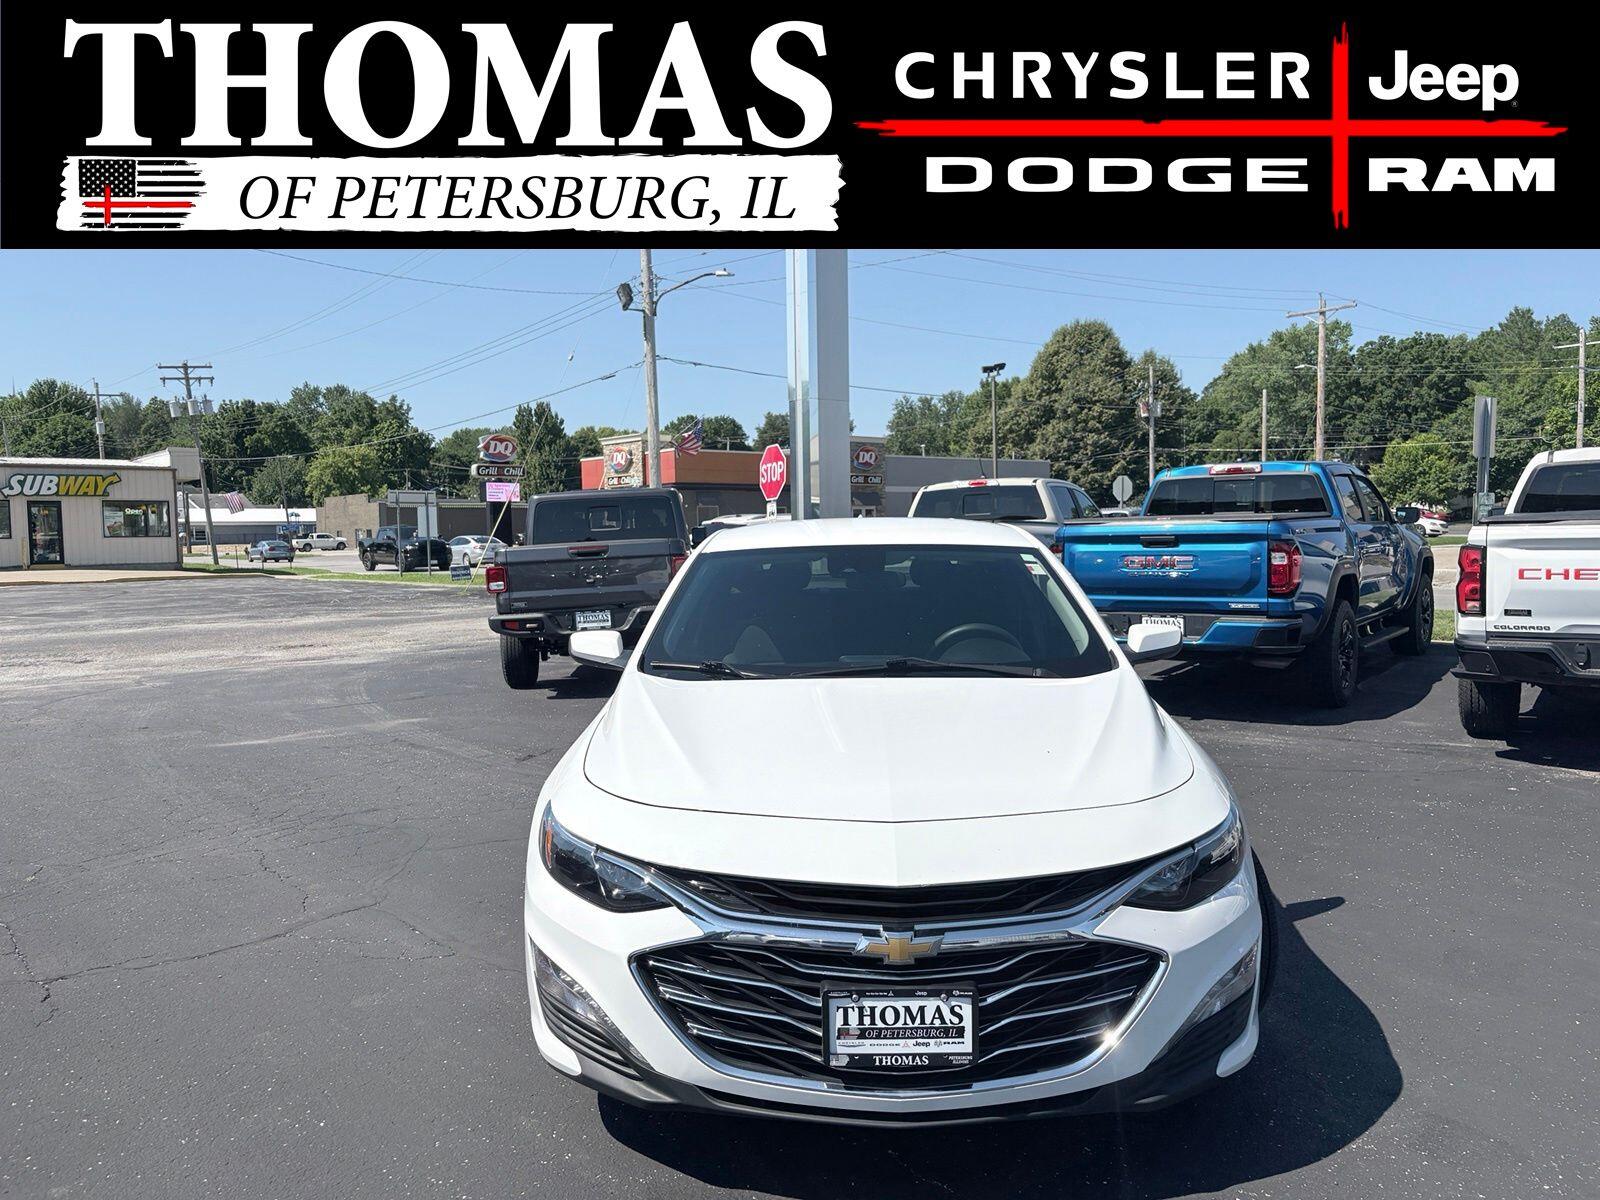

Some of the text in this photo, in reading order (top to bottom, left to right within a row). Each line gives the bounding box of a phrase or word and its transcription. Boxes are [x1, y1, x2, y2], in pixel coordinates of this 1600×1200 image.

[488, 440, 513, 456] DQ
[613, 451, 626, 466] DQ
[859, 451, 876, 465] DQ
[479, 466, 523, 476] Grill Chill
[761, 461, 784, 484] STOP
[1, 473, 121, 497] SUBWAY
[1124, 555, 1194, 569] GMC
[1518, 568, 1600, 580] CHE
[577, 613, 609, 621] THOMAS
[836, 1004, 964, 1027] THOMAS
[865, 1028, 958, 1038] OF PETERSBURG, IL
[912, 1040, 931, 1048] Jeep
[873, 1055, 929, 1066] THOMAS
